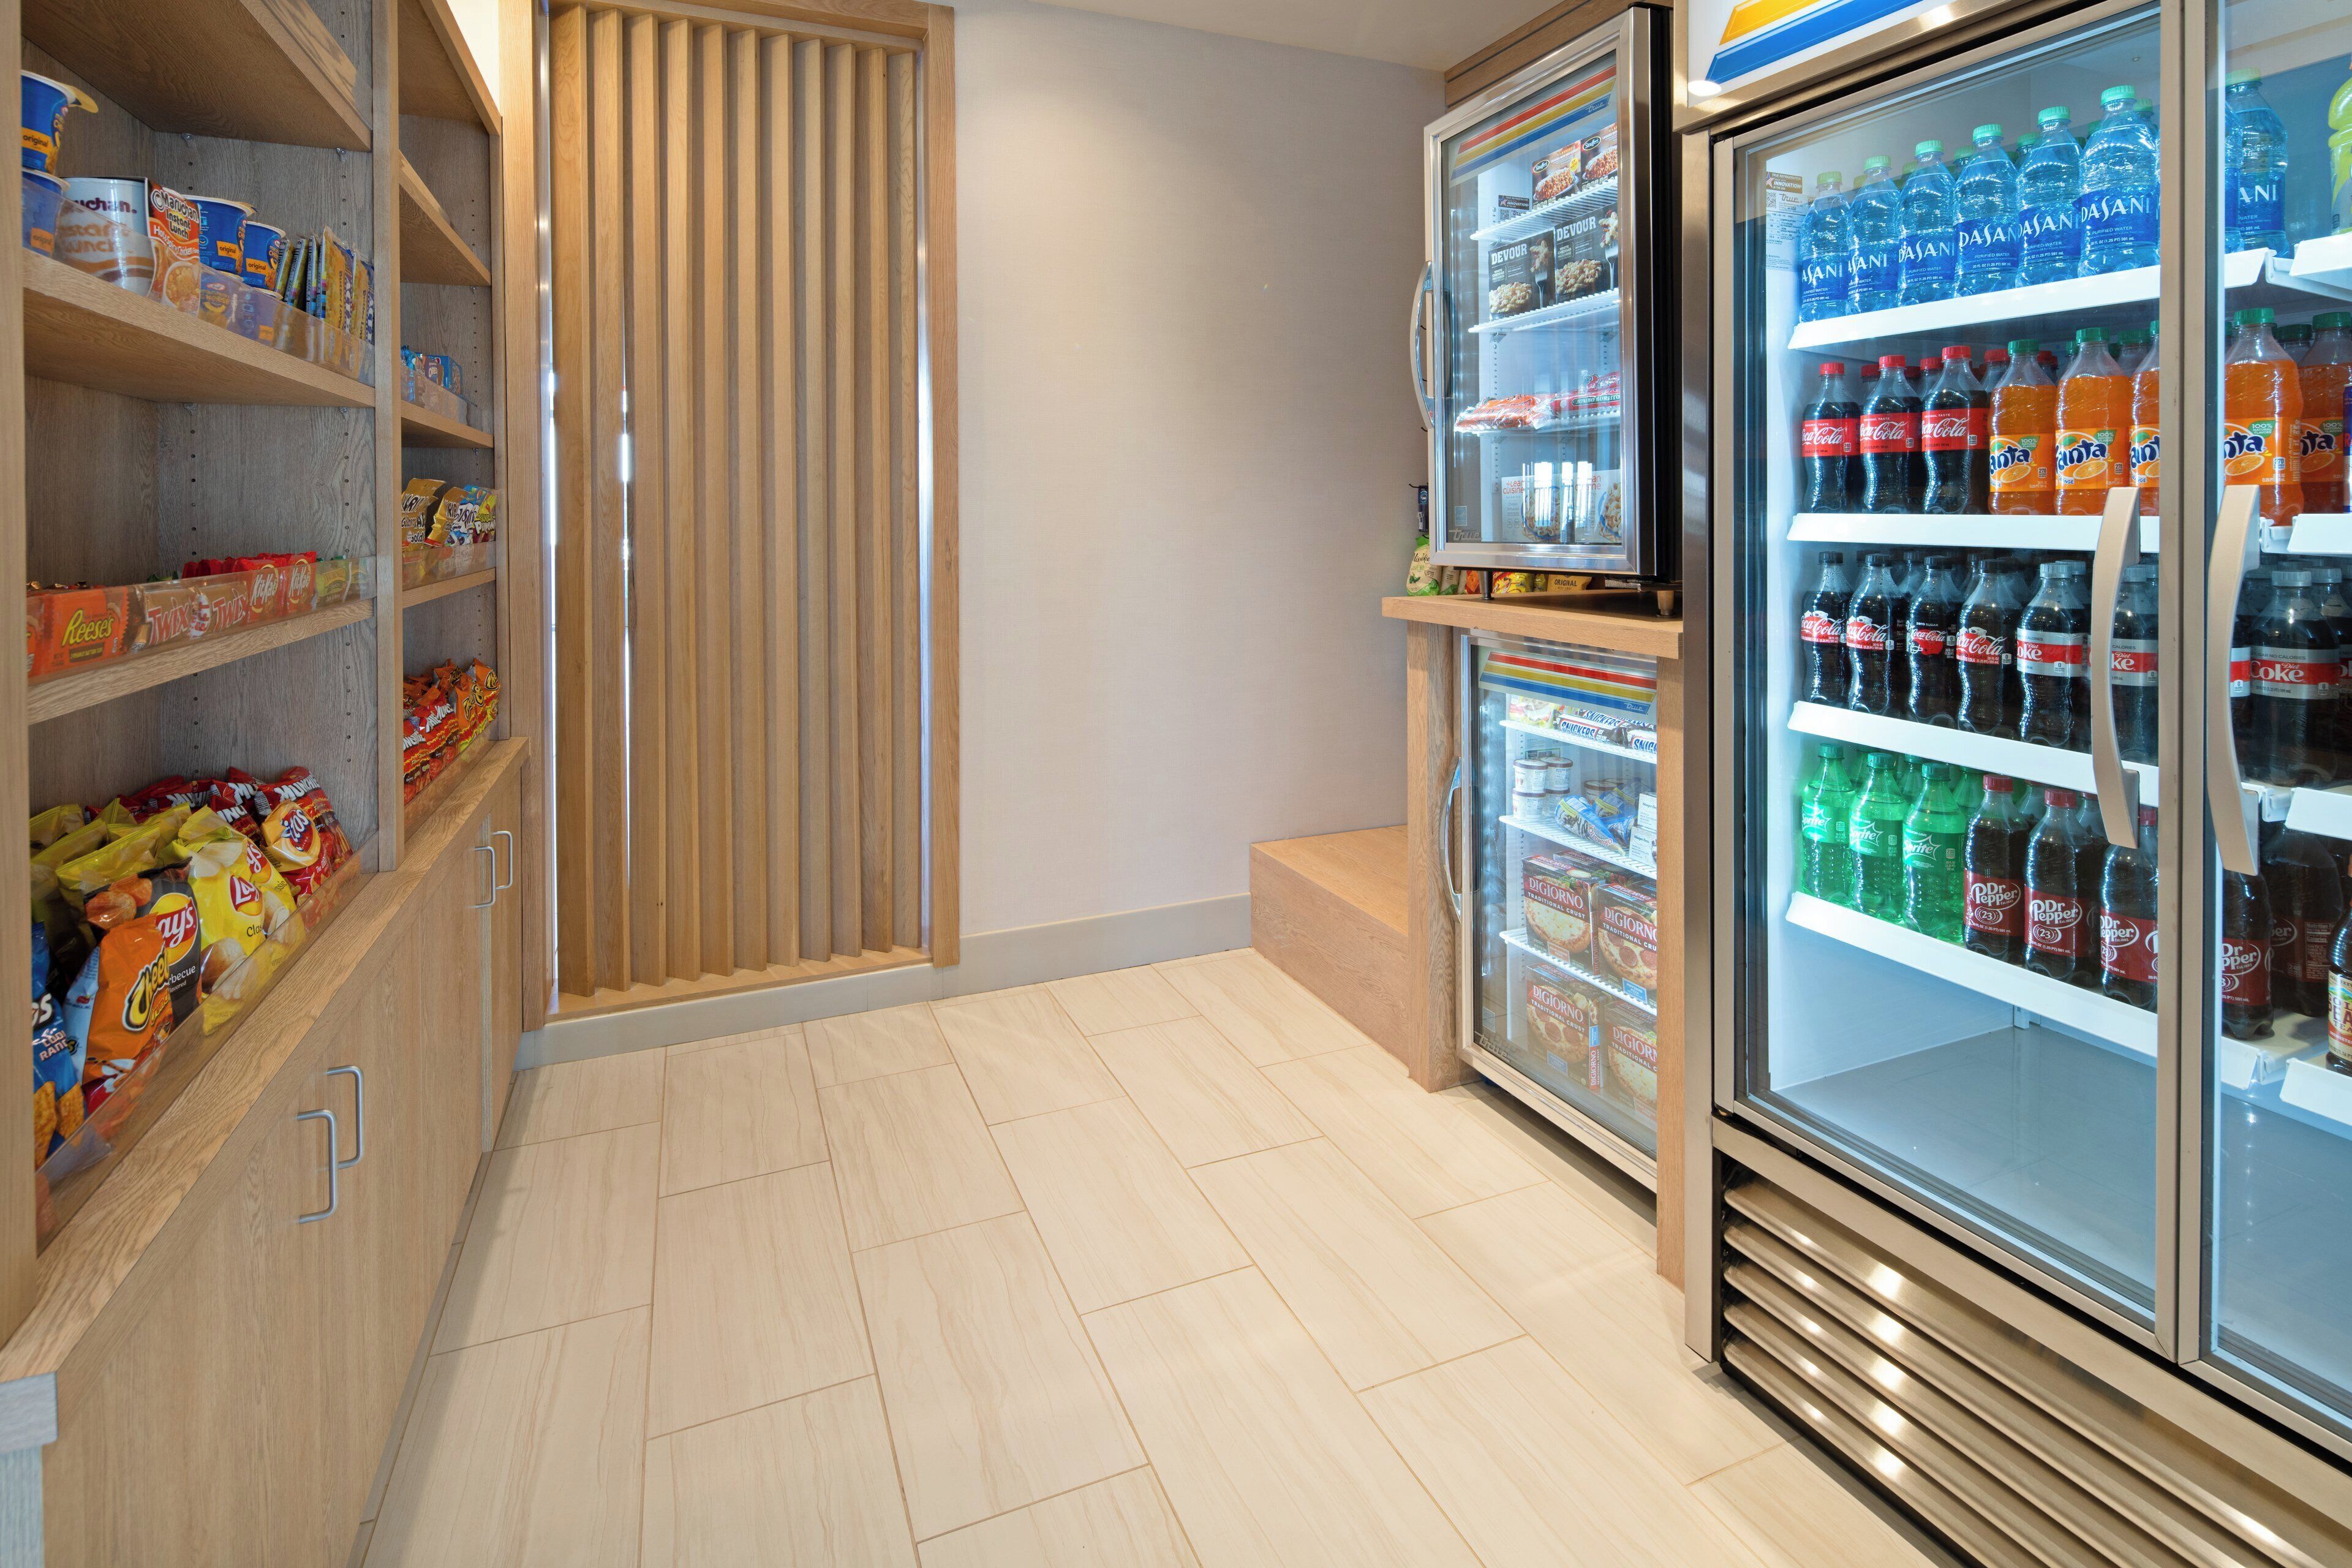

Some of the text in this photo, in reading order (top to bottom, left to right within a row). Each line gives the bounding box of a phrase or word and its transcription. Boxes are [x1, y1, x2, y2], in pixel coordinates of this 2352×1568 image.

[23, 134, 48, 148] original
[1779, 193, 1800, 203] true
[2081, 196, 2150, 223] DASANI
[166, 208, 191, 231] Instant
[170, 220, 189, 241] Lunch
[1556, 216, 1597, 242] DEVOUR
[220, 246, 236, 254] original
[1491, 243, 1528, 266] DEVOUR
[1898, 239, 1955, 263] DASANI
[248, 262, 266, 271] original
[1503, 486, 1525, 495] cuisine
[250, 573, 277, 606] KitKat
[288, 566, 311, 598] KitKat
[62, 608, 115, 647] Reese's
[146, 597, 189, 646] Twix
[1910, 628, 1948, 643] Coca-Cola
[2017, 644, 2042, 660] oke
[2251, 660, 2304, 683] Coke
[1561, 722, 1596, 739] SNICKERS
[1585, 710, 1621, 728] SNICKERS
[1904, 840, 1934, 854] Sprite
[1529, 876, 1584, 910] DIGIORNO
[1971, 882, 2017, 906] Pepper
[1986, 882, 2007, 896] Dr
[1528, 891, 1586, 919] TRADITIONAL CRUST
[1981, 911, 1992, 921] 23
[2030, 899, 2079, 925] Pepper
[2044, 899, 2066, 913] Dr
[2104, 916, 2120, 928] Dr
[1602, 922, 1642, 946] TRADITIONAL
[2039, 929, 2051, 939] 23
[2222, 943, 2244, 958] Dr
[1531, 999, 1586, 1033] TRADITIONAL CRUST
[1532, 985, 1585, 1024] DIGIORNO
[1611, 1041, 1651, 1069] TRADITIONAL
